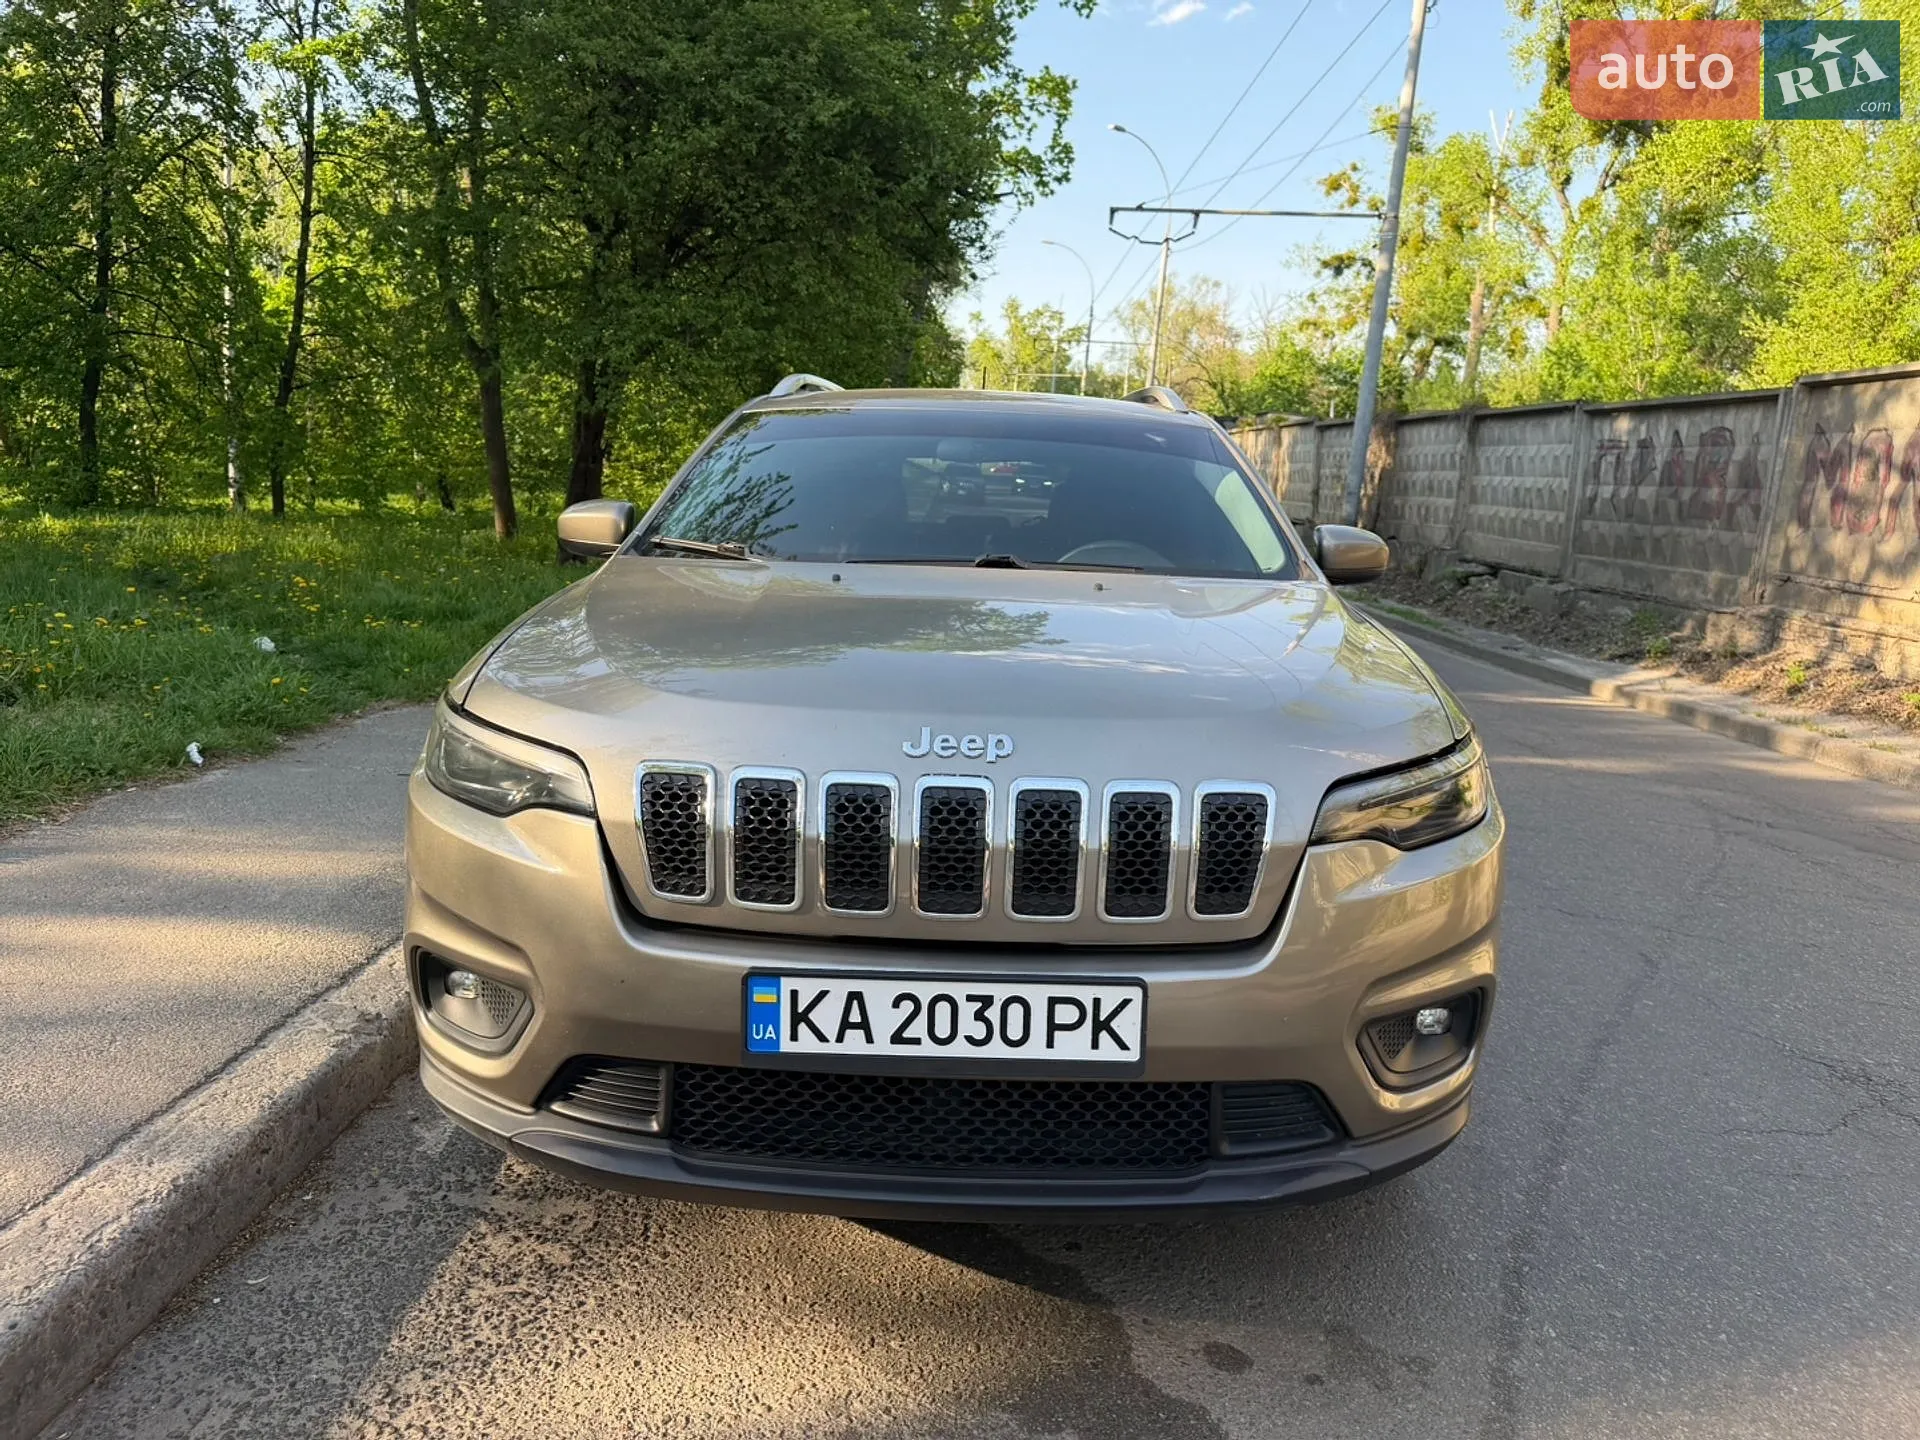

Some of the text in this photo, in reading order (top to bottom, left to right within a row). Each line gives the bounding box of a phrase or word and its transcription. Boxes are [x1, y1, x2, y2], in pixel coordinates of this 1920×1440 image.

[902, 726, 1014, 763] Jeep
[752, 1023, 777, 1040] UA
[789, 989, 1133, 1051] KA 2030 PK
